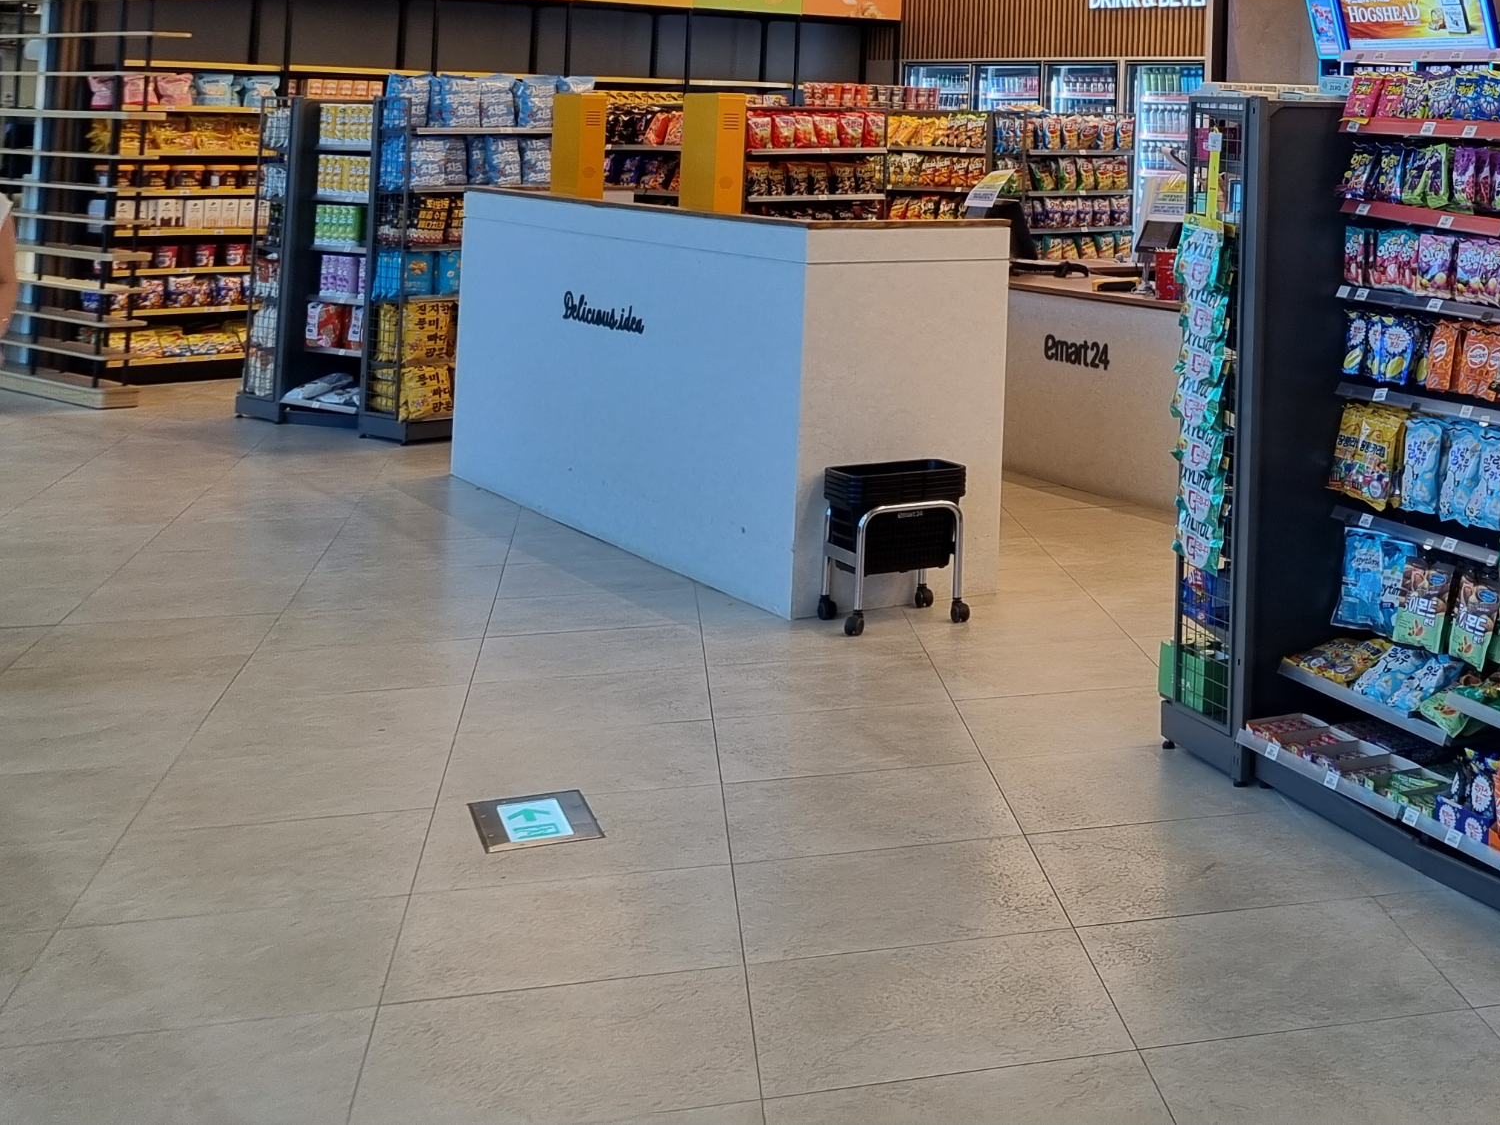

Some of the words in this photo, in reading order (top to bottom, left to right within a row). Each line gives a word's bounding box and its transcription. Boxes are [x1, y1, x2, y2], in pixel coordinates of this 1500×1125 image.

[1346, 2, 1421, 23] HOGSHEAD
[562, 290, 619, 330] Delicious
[616, 305, 645, 335] idea
[1043, 333, 1110, 371] emart24
